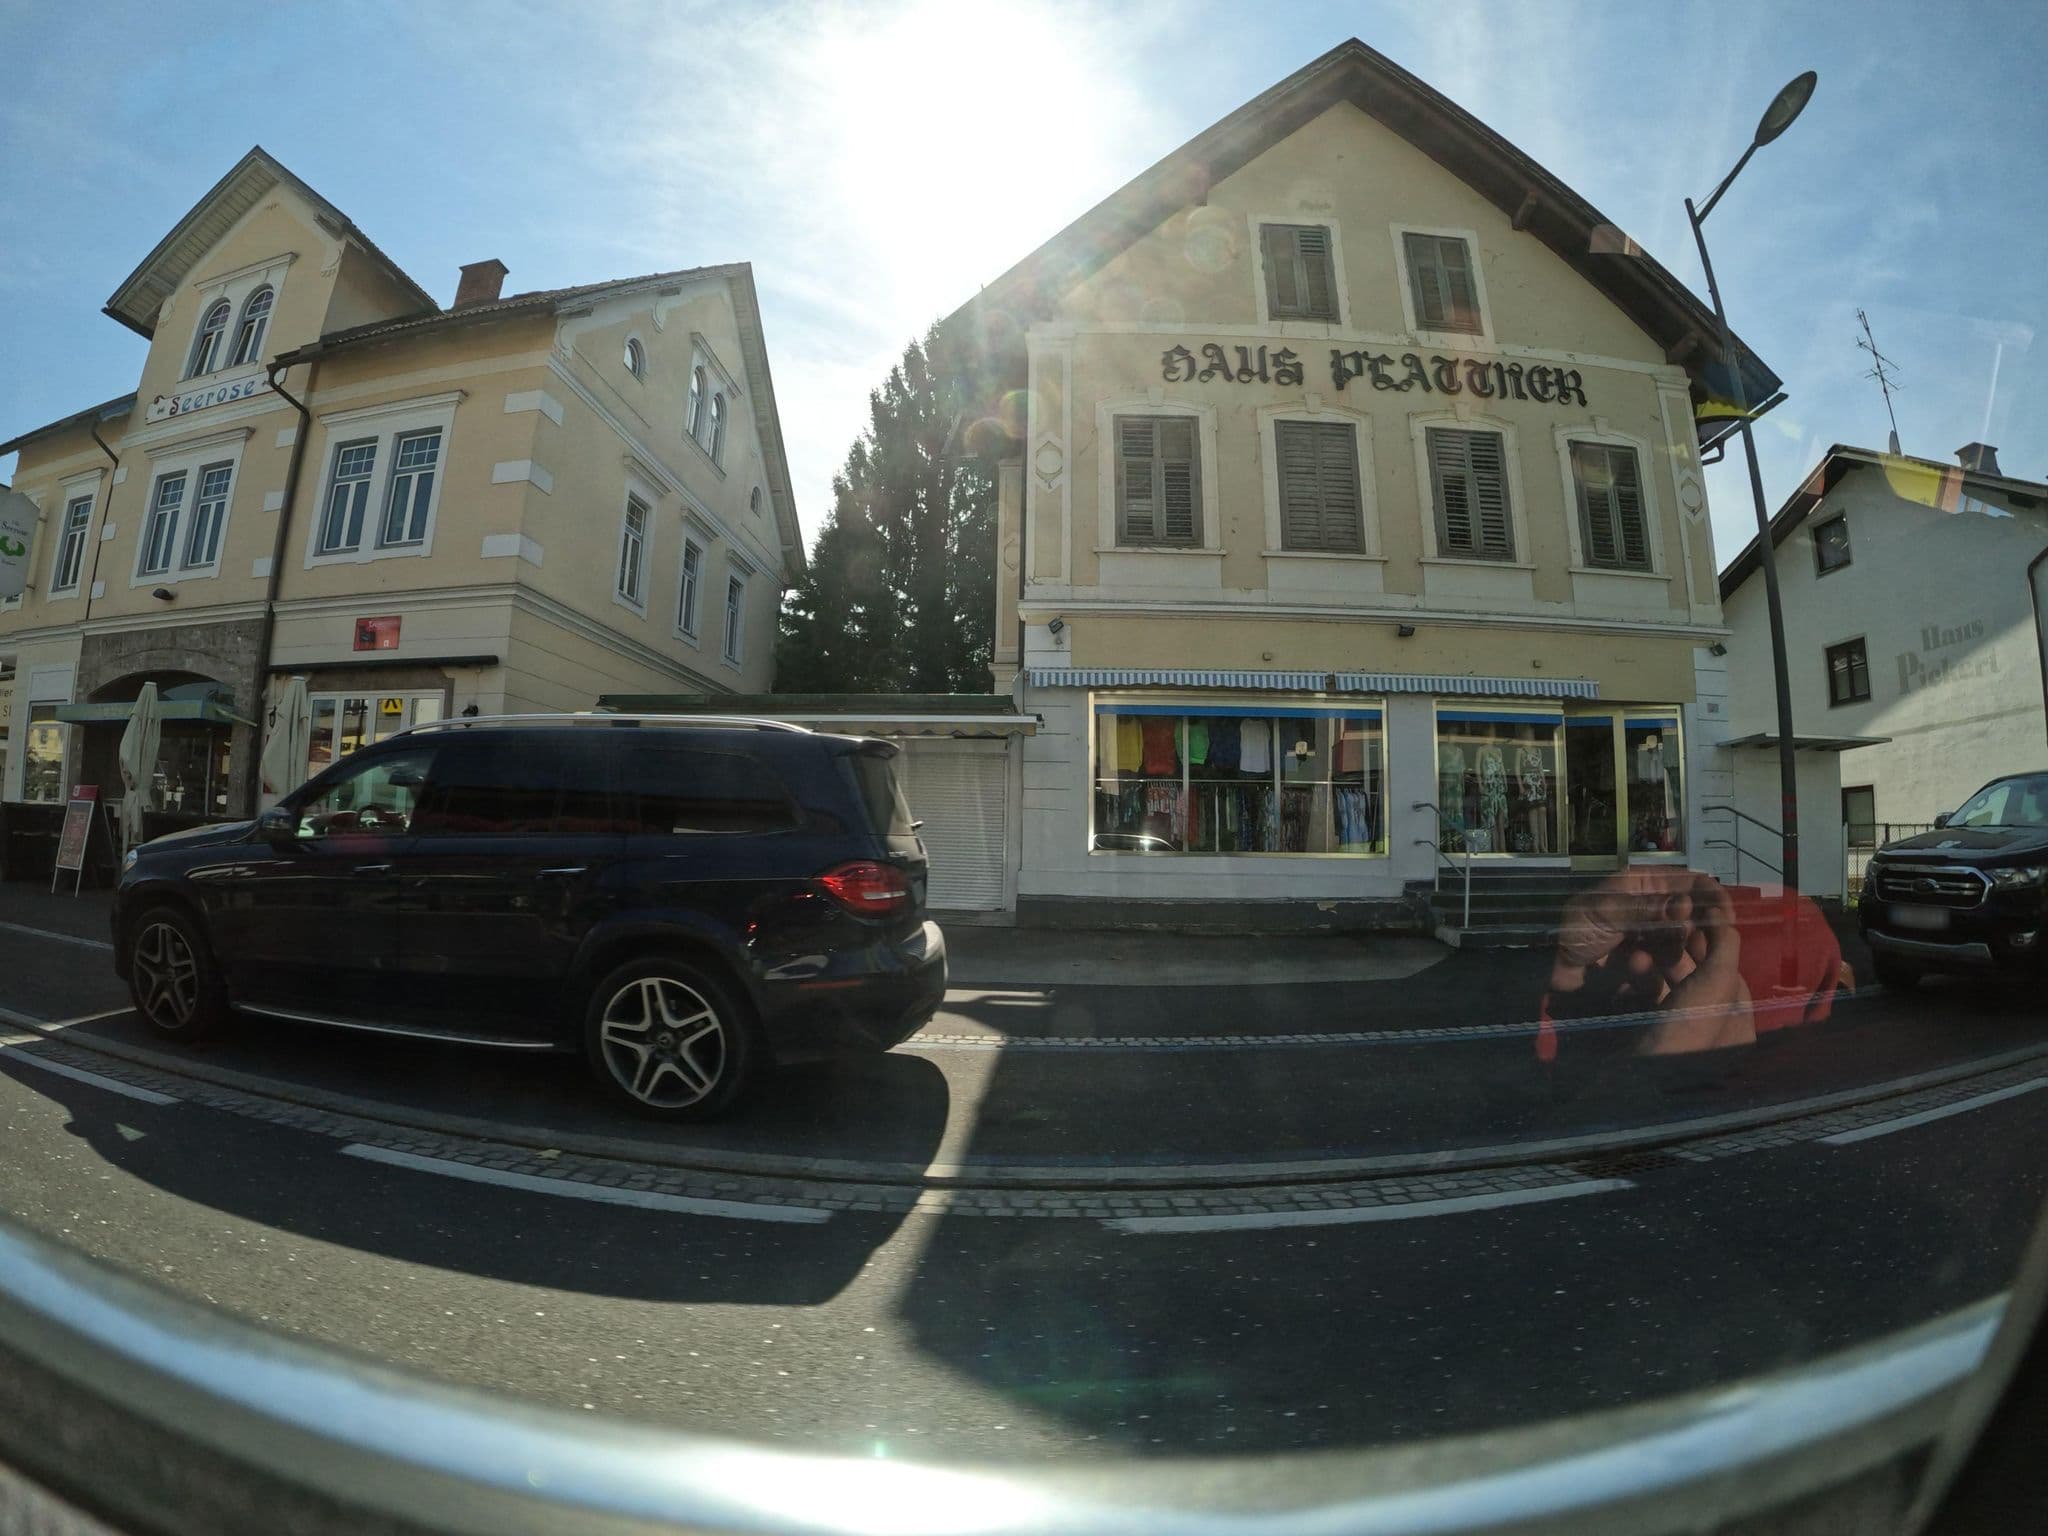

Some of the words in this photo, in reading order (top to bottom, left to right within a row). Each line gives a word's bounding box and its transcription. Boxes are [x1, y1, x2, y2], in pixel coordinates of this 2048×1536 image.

[1162, 343, 1304, 386] HAUS
[1330, 349, 1588, 407] PLATTNER
[169, 381, 255, 415] Seerose
[1922, 619, 1985, 651] Haus
